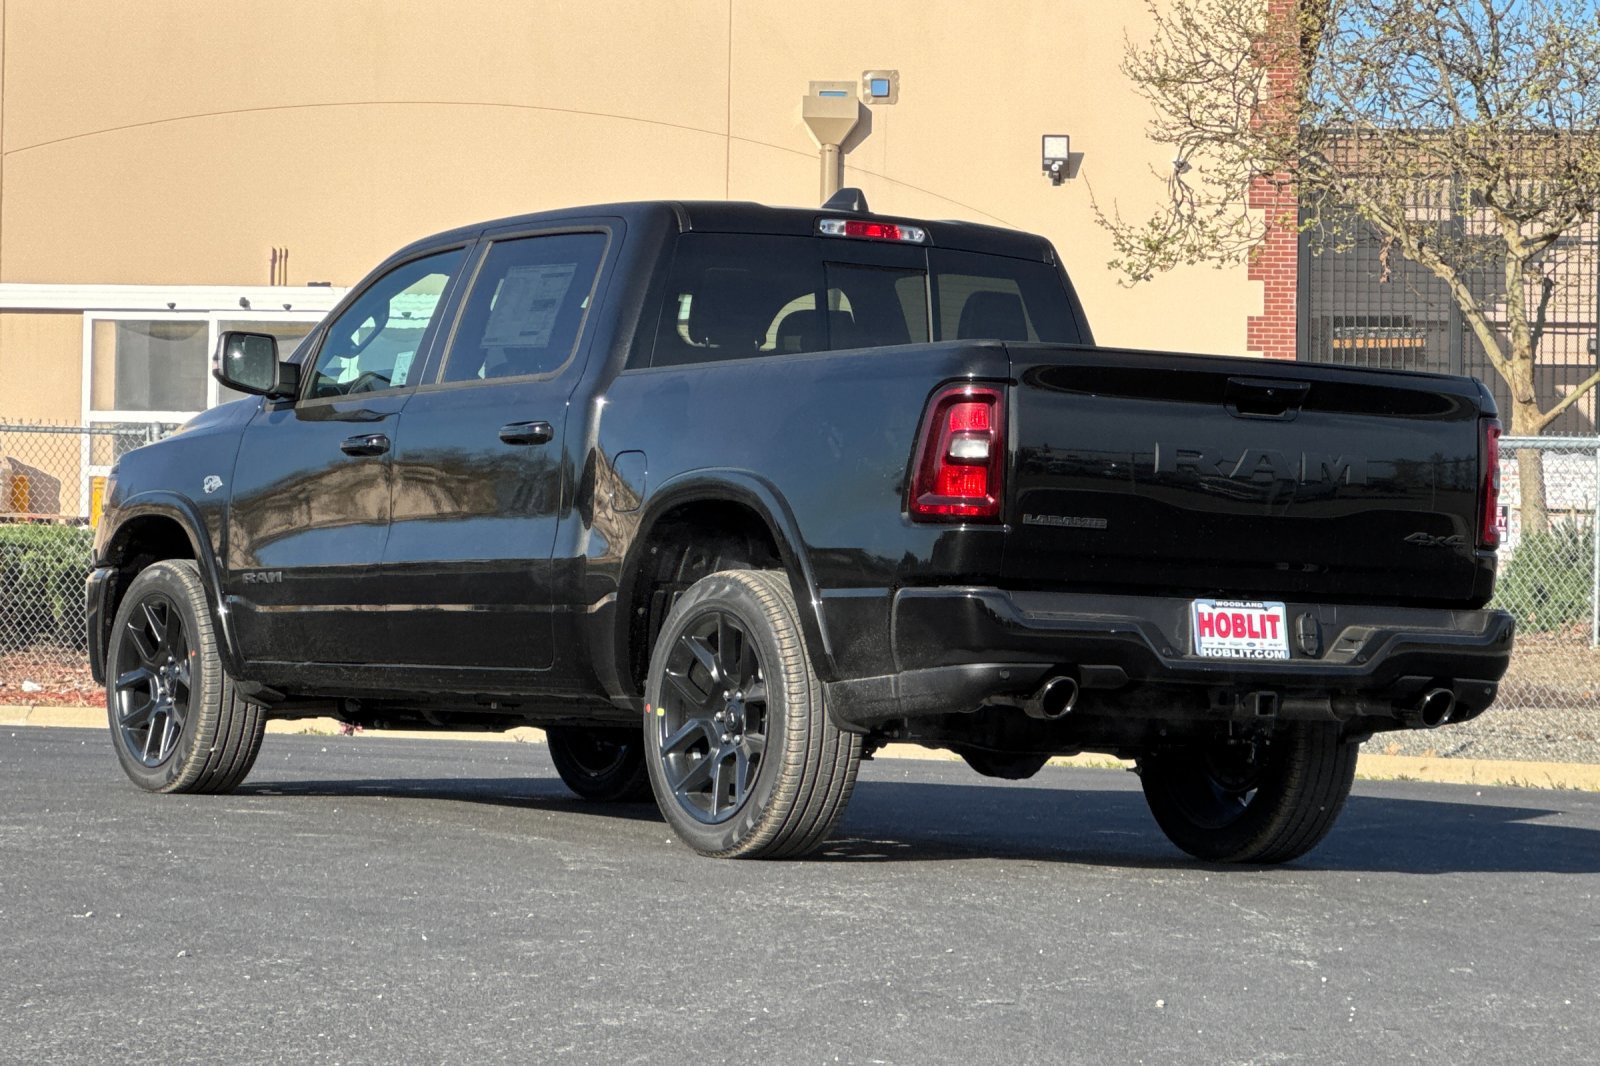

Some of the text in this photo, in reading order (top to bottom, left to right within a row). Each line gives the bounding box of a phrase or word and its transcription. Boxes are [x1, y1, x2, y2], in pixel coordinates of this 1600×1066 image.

[1154, 441, 1368, 485] RAM
[242, 571, 282, 583] RAM
[1215, 600, 1263, 609] WOODLAND
[1198, 611, 1280, 639] HOBLIT
[1203, 647, 1286, 659] HOBLIT.COM
